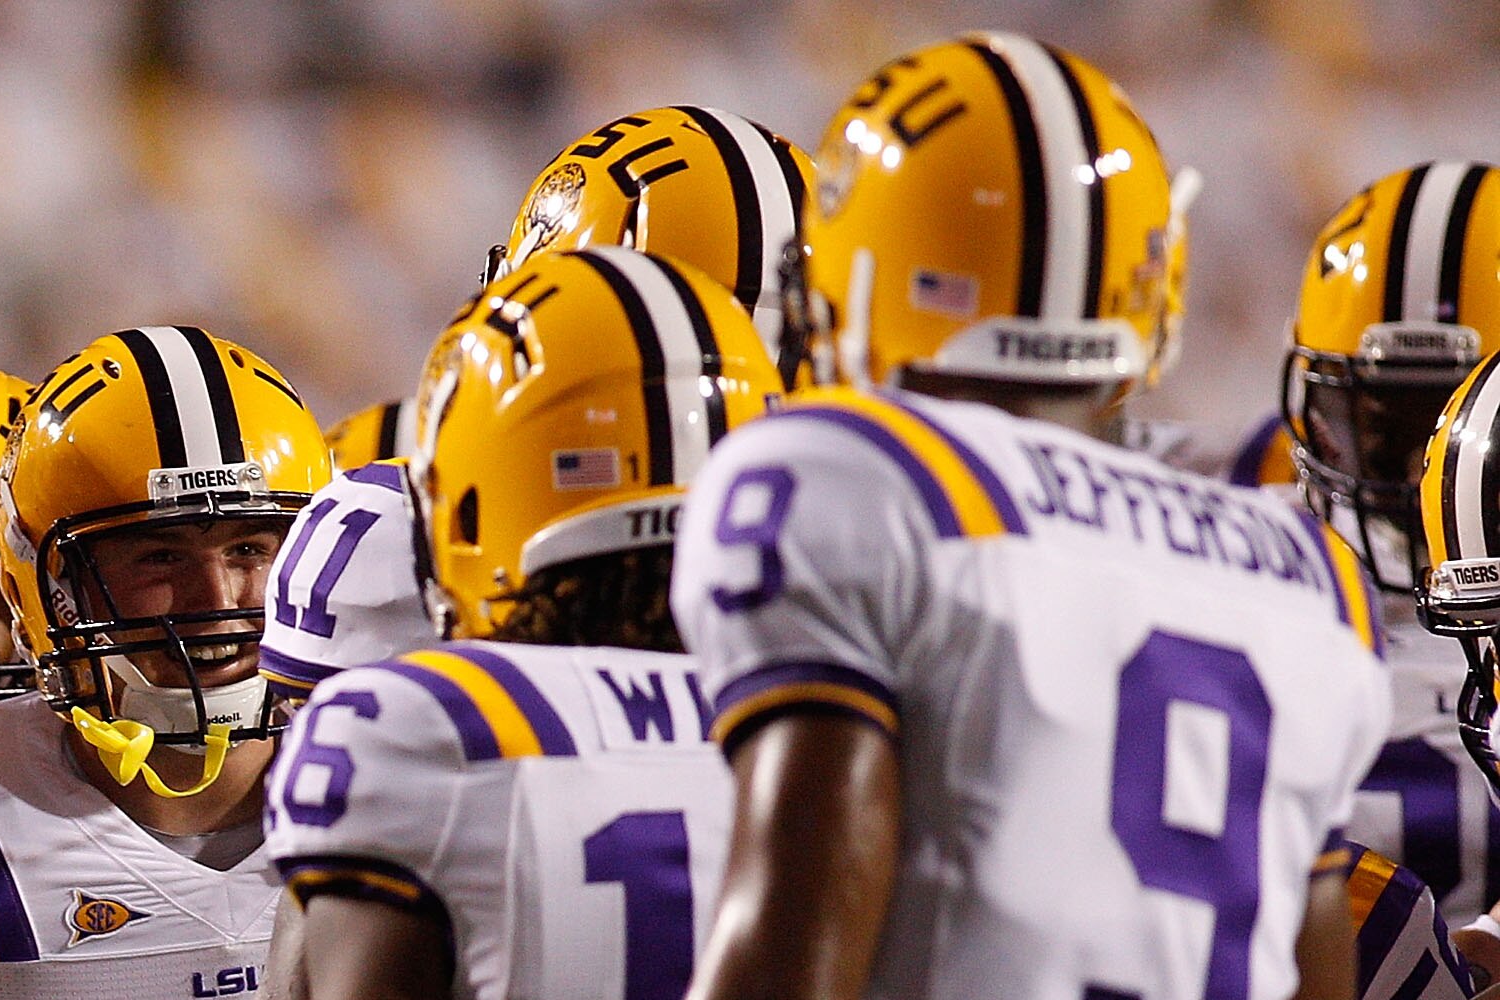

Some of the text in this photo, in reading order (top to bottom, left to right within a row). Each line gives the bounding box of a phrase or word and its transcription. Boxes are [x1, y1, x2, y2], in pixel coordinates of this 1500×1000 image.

[840, 56, 967, 148] SU
[560, 116, 689, 199] SU
[996, 329, 1118, 361] TIGERS
[177, 469, 238, 491] TIGERS
[1018, 438, 1322, 594] JEFFERSON
[275, 497, 382, 640] 11
[713, 465, 799, 614] 9
[1452, 565, 1499, 585] TIGERS
[265, 690, 382, 830] 6
[85, 902, 117, 932] SEC
